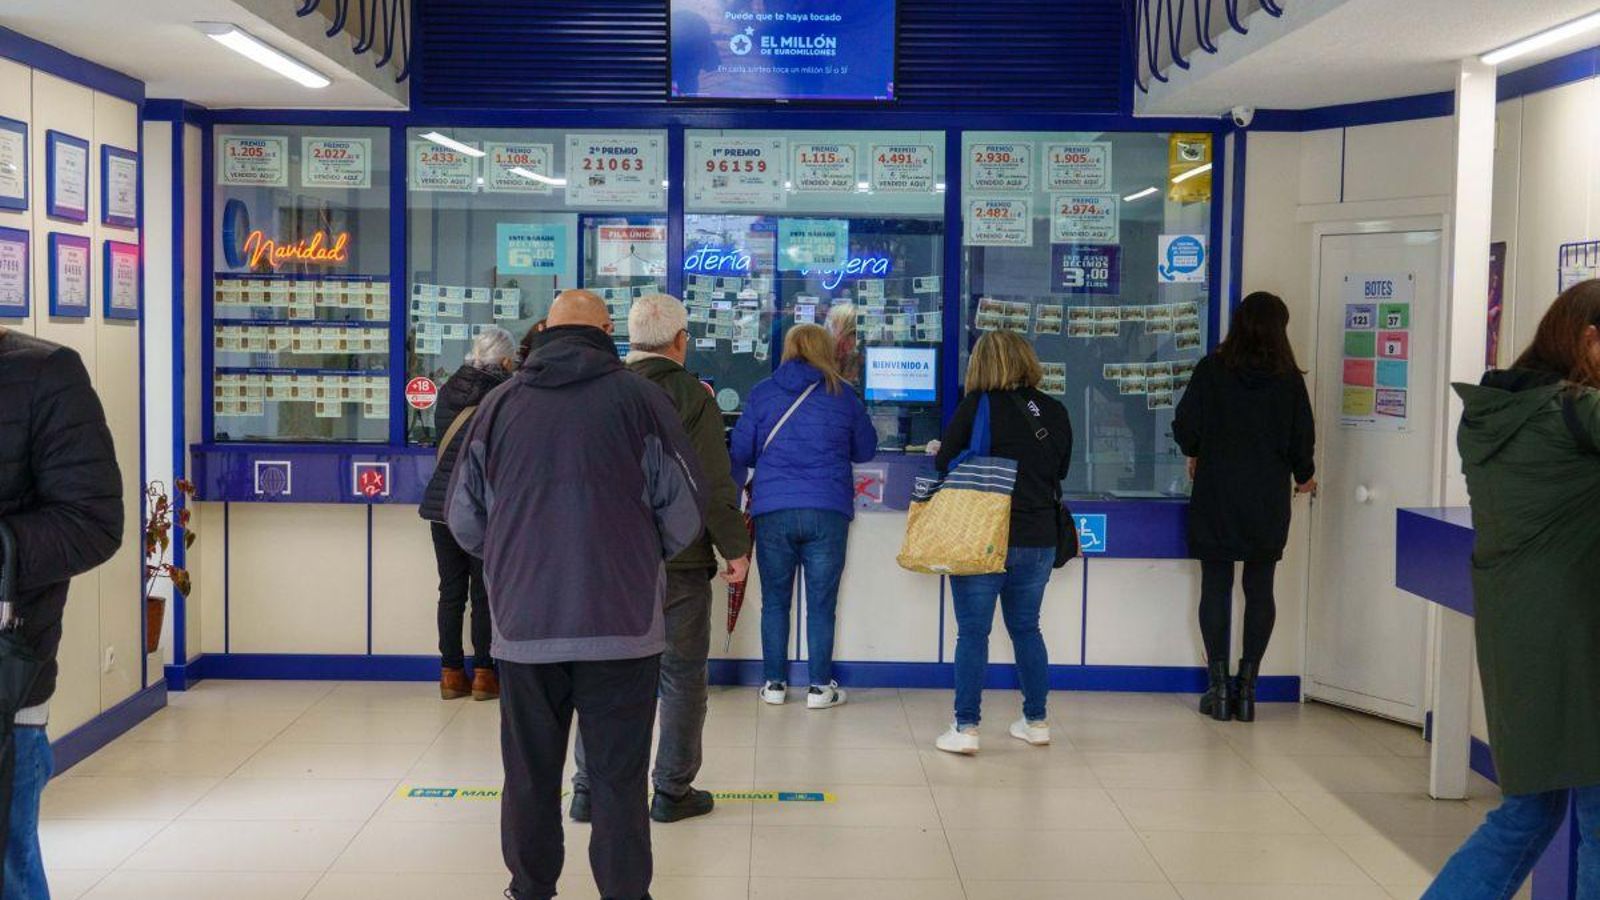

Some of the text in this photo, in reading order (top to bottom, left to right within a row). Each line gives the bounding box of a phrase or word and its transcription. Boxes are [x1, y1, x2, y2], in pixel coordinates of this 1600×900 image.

[724, 12, 842, 23] Puede que te haya tocado
[760, 33, 837, 48] EL MILLÓN
[602, 146, 638, 155] PREMIO
[724, 148, 760, 157] PREMIO
[583, 158, 643, 170] 21063
[706, 160, 767, 172] 96159
[243, 228, 348, 268] Navidad
[683, 244, 751, 271] otería
[1364, 280, 1393, 296] BOTES
[1353, 315, 1368, 325] 123
[1388, 316, 1399, 326] 37
[1388, 343, 1394, 354] 9
[872, 361, 929, 370] BIENVENIDO A
